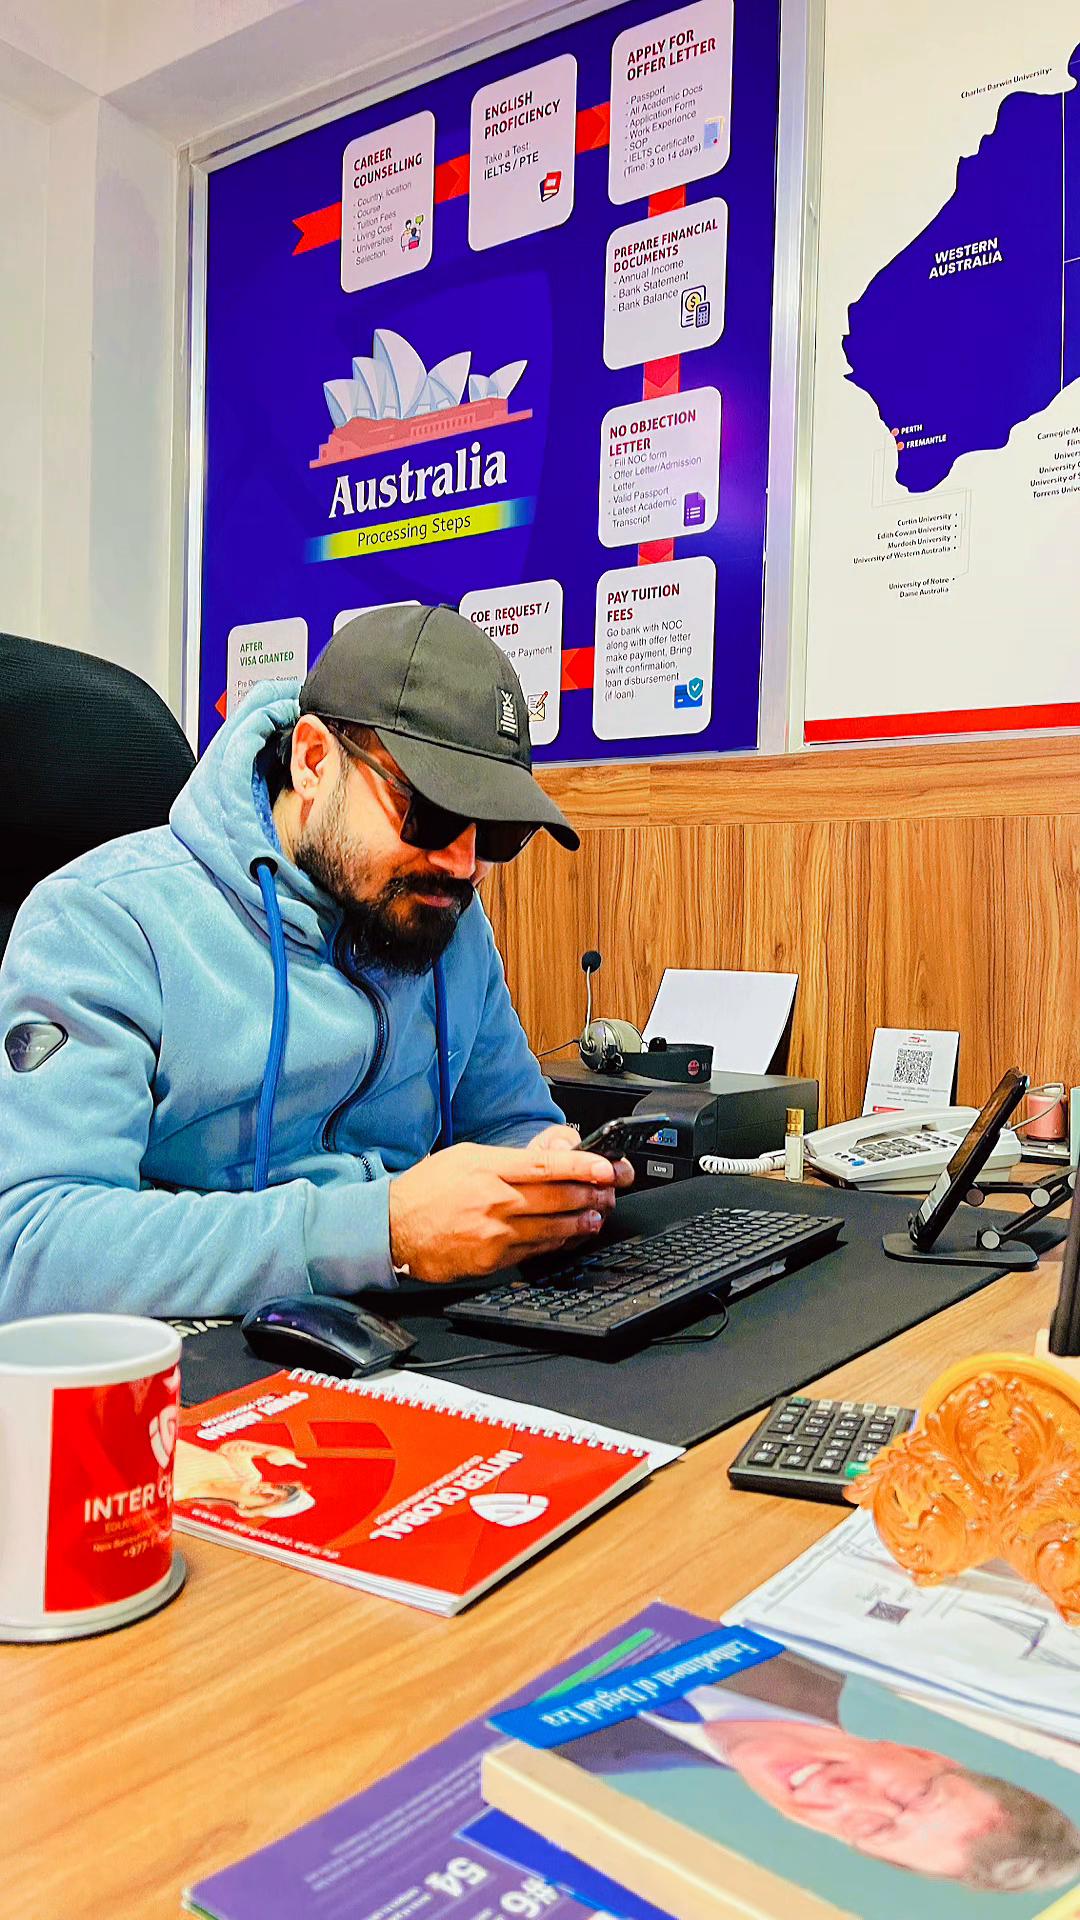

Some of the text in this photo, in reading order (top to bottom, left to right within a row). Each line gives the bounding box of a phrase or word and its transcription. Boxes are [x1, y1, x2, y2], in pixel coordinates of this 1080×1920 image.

[627, 29, 694, 65] APPLY FOR
[627, 38, 716, 81] OFFER LETTER
[961, 69, 1049, 98] Charles Darwin University
[630, 86, 665, 105] Passport
[630, 84, 703, 117] All Academic Docs
[485, 91, 533, 121] ENGLISH
[629, 99, 696, 128] Application Form
[484, 99, 560, 140] PROFICIENCY
[629, 110, 696, 140] Work Experience
[485, 142, 530, 165] Take a Test
[629, 138, 648, 151] SOP
[629, 134, 694, 162] IELTS Certificate
[354, 147, 392, 171] CAREER
[649, 157, 655, 167] 3
[657, 155, 665, 166] to
[668, 151, 676, 162] 14
[678, 143, 701, 158] days)
[354, 153, 422, 188] COUNSELLING
[484, 162, 511, 180] IELTS
[520, 152, 539, 167] PTE
[386, 182, 412, 196] location
[357, 204, 380, 218] Course
[357, 210, 396, 230] Tuition Fees
[357, 223, 393, 242] Living Cost
[614, 218, 718, 260] PREPARE FINANCIAL
[357, 235, 394, 253] Universities
[934, 237, 998, 264] WESTERN
[356, 250, 386, 266] Selection
[613, 244, 679, 273] DOCUMENTS
[929, 250, 1003, 279] AUSTRALIA
[618, 259, 684, 285] Annual Income
[618, 271, 689, 299] Bank Statement
[618, 288, 679, 312] Bank Balance
[610, 409, 696, 439] NO OBJECTION
[901, 424, 923, 434] PERTH
[1038, 428, 1070, 440] Carnegie
[609, 438, 651, 457] LETTER
[906, 434, 947, 449] FREMANTLE
[614, 458, 626, 468] Fill
[628, 453, 647, 465] NOC
[614, 456, 702, 480] Offer Letter/Admission
[1039, 463, 1075, 474] University
[329, 442, 507, 519] Australia
[613, 481, 635, 492] Letter
[1030, 476, 1067, 487] University
[613, 486, 669, 504] Valid Passport
[1033, 489, 1059, 498] Torrens
[612, 498, 677, 516] Latest Academic
[612, 514, 650, 528] Transcript
[919, 513, 952, 523] University
[358, 514, 471, 548] Processing Steps
[895, 529, 916, 537] Cowan
[918, 524, 951, 534] University
[888, 535, 951, 548] Murdoch University
[854, 555, 885, 564] University
[894, 549, 920, 558] Western
[921, 546, 950, 555] Australia
[607, 583, 680, 605] PAY TUITION
[889, 581, 921, 590] University
[920, 587, 949, 596] Australia
[471, 610, 490, 623] COE
[496, 603, 542, 620] REQUEST
[607, 608, 633, 622] FEES
[607, 619, 683, 637] Go bank with NOC
[240, 642, 263, 653] AFTER
[606, 632, 691, 652] along with offer letter
[240, 651, 294, 666] VISA GRANTED
[519, 646, 552, 659] Payment
[606, 652, 627, 662] make
[670, 645, 692, 656] Bring
[606, 664, 624, 675] swift
[605, 672, 679, 688] loan disbursement
[454, 1450, 524, 1490] INTER
[84, 1482, 156, 1524] INTER
[369, 1487, 467, 1540] GLOBAL
[633, 1678, 659, 1698] of
[576, 1685, 648, 1720] Digital
[538, 1706, 589, 1727] Era
[425, 1856, 488, 1897] 54
